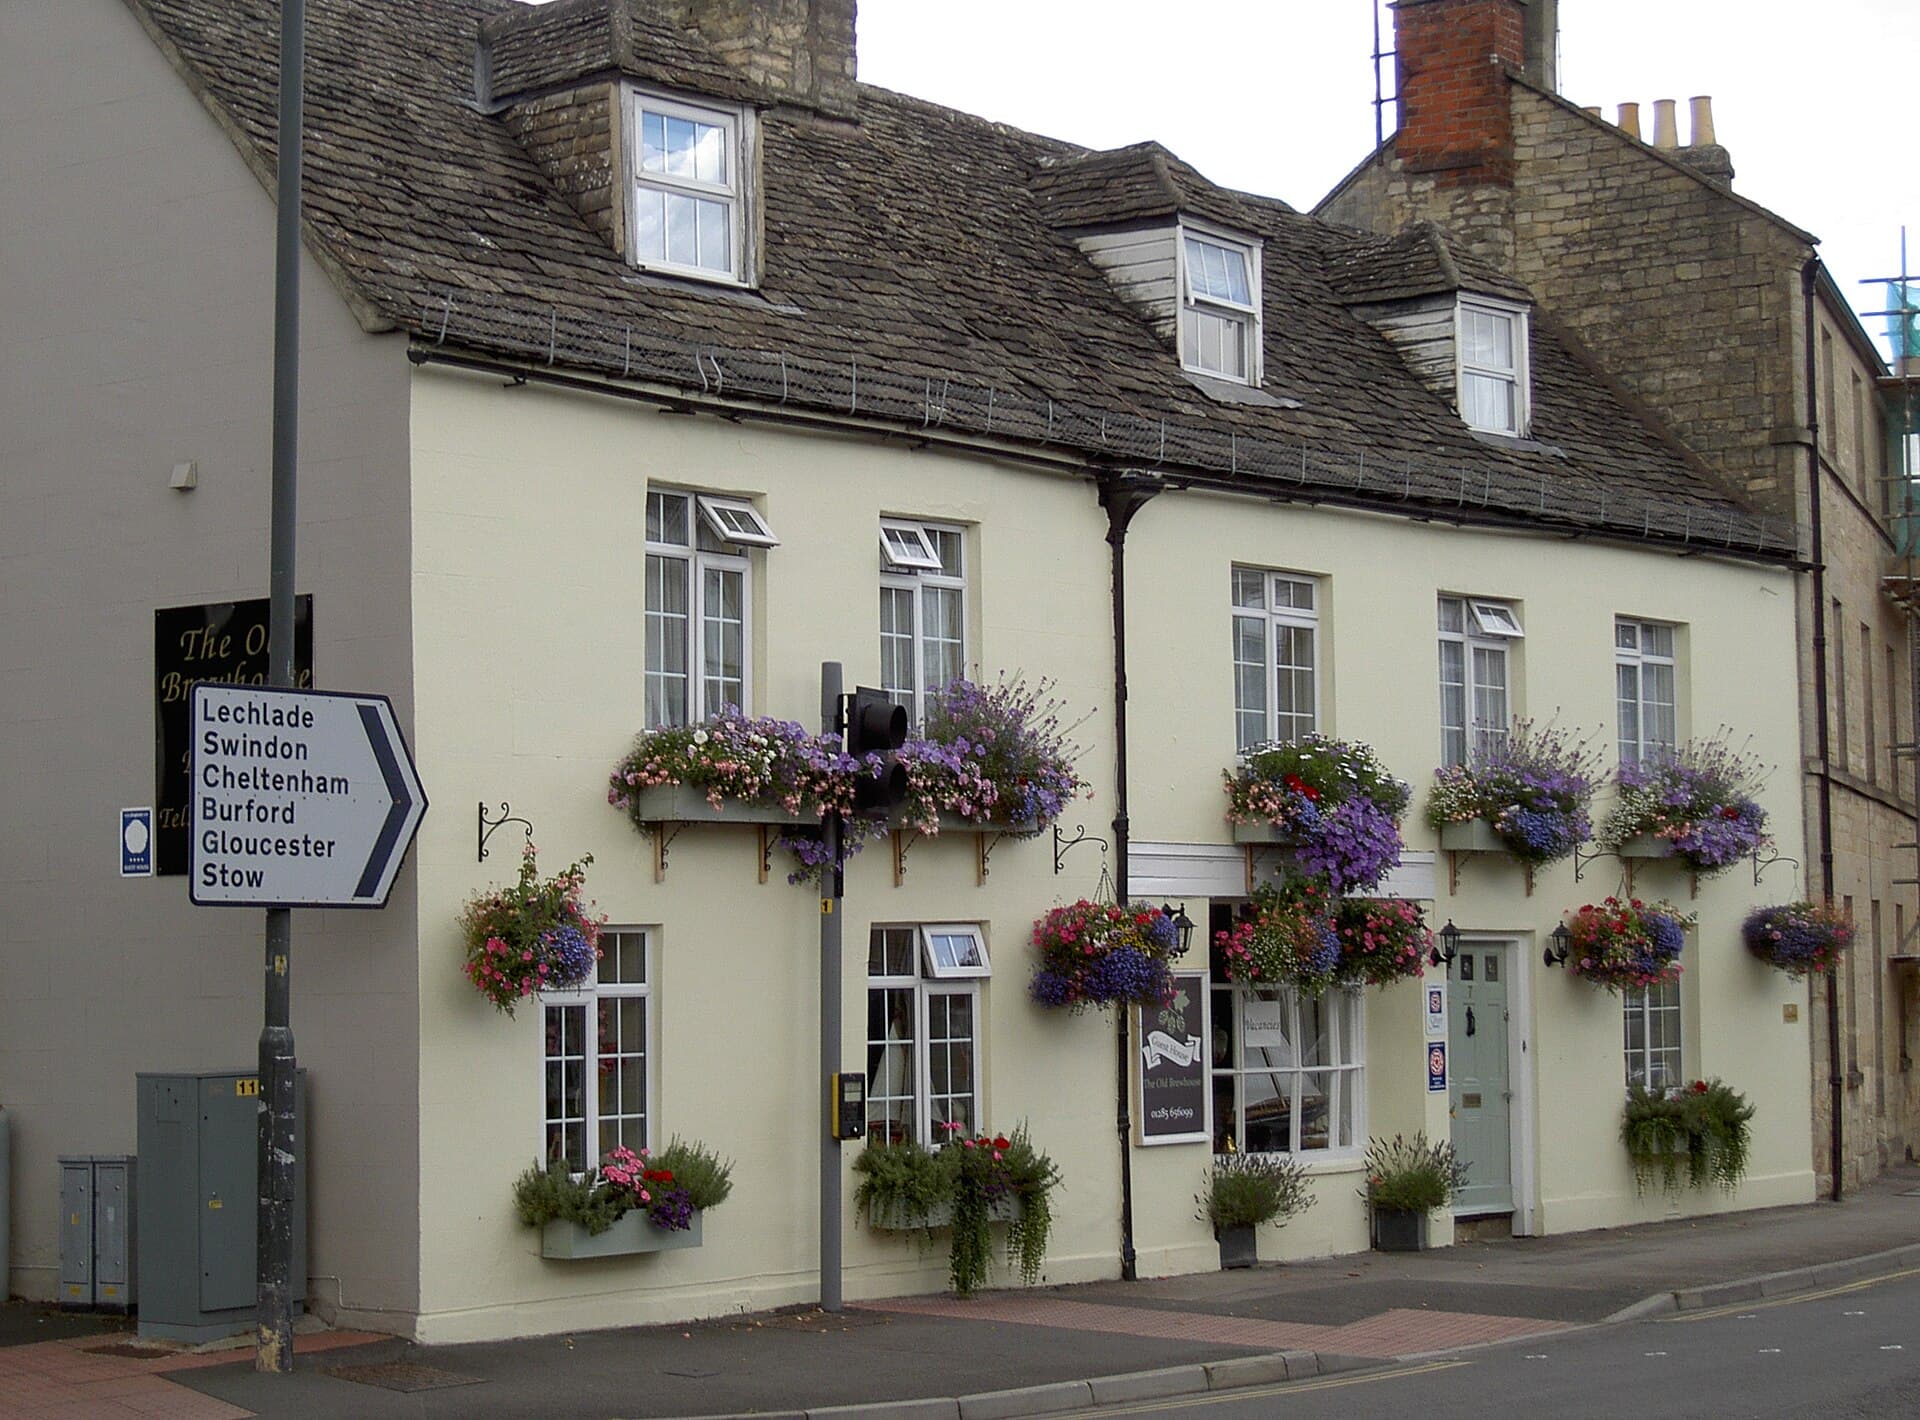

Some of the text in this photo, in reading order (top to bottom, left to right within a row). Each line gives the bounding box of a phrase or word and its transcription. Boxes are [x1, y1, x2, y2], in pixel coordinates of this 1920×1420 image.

[180, 623, 231, 661] The
[203, 698, 314, 728] Lechlade
[203, 731, 308, 760] Swindon
[203, 764, 349, 794] Cheltenham
[202, 797, 295, 824] Burford
[202, 830, 336, 857] Gloucester
[202, 863, 264, 888] Stow
[239, 1080, 256, 1094] 11
